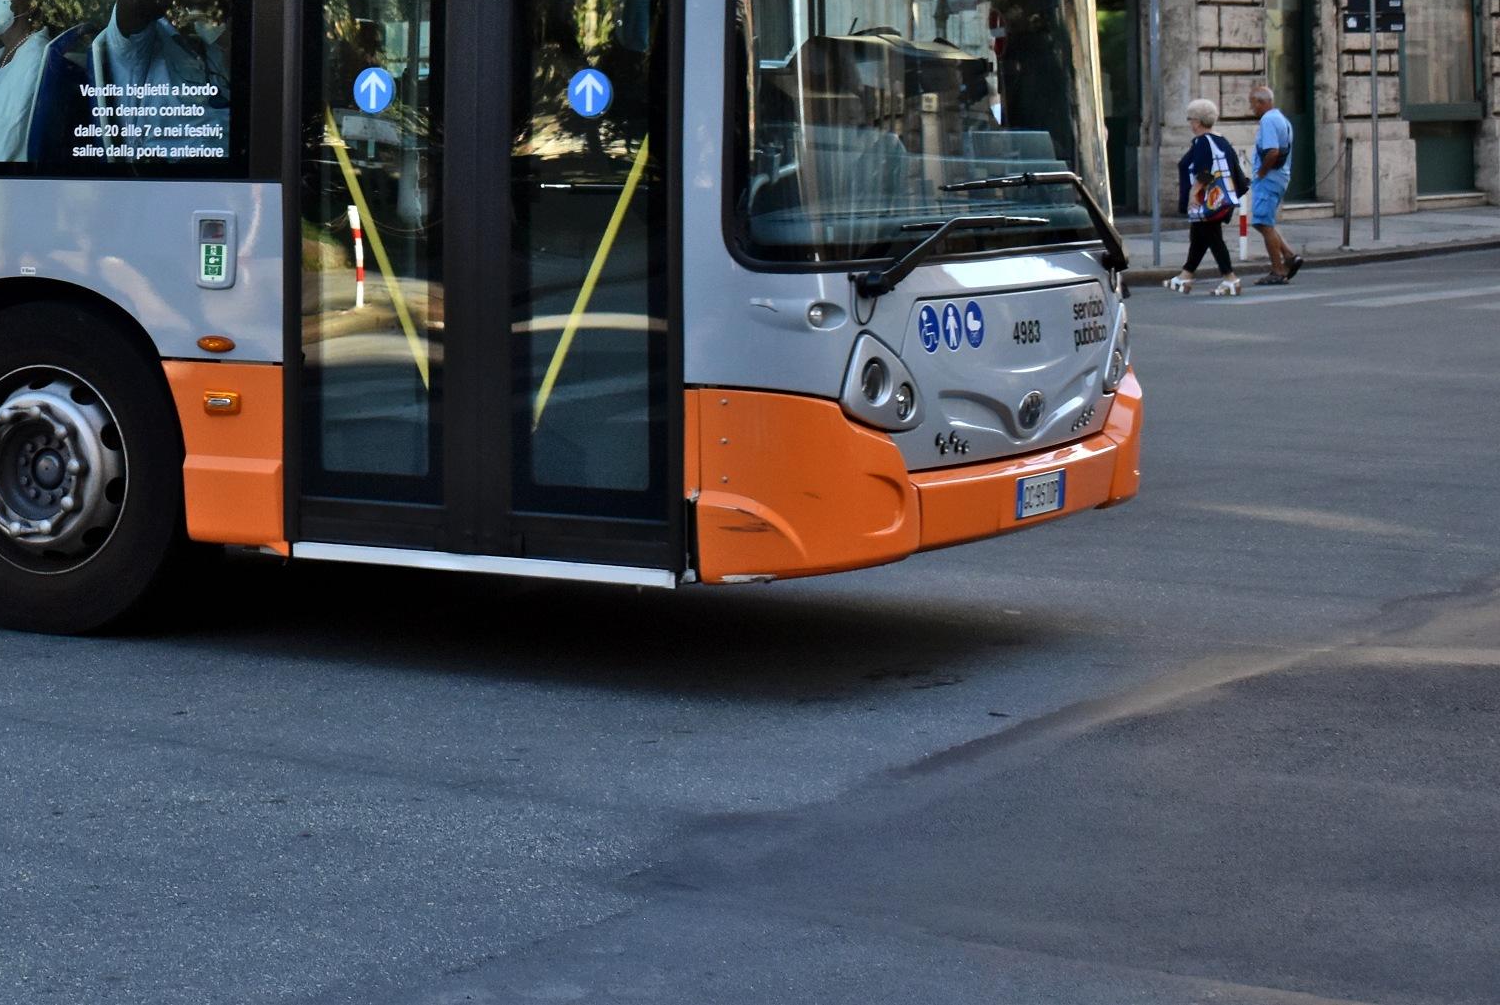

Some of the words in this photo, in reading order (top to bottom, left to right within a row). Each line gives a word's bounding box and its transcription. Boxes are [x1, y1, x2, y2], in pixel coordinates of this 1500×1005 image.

[80, 83, 123, 96] Vendita
[126, 82, 169, 99] biglietti
[172, 86, 179, 96] a
[182, 83, 218, 96] bordo
[92, 106, 114, 117] con
[116, 104, 158, 117] denaro
[159, 104, 205, 117] contato
[74, 124, 102, 137] dalle
[104, 125, 119, 137] 20
[120, 124, 143, 137] alle
[144, 125, 151, 137] 7
[153, 127, 164, 137] e
[164, 124, 182, 137] nei
[184, 124, 224, 139] festivi;
[72, 144, 104, 157] salire
[106, 144, 134, 157] dalla
[136, 146, 168, 160] porta
[170, 145, 224, 158] anteriore
[1073, 295, 1104, 321] servizio
[1013, 320, 1041, 344] 4983
[1074, 320, 1107, 353] pubblico
